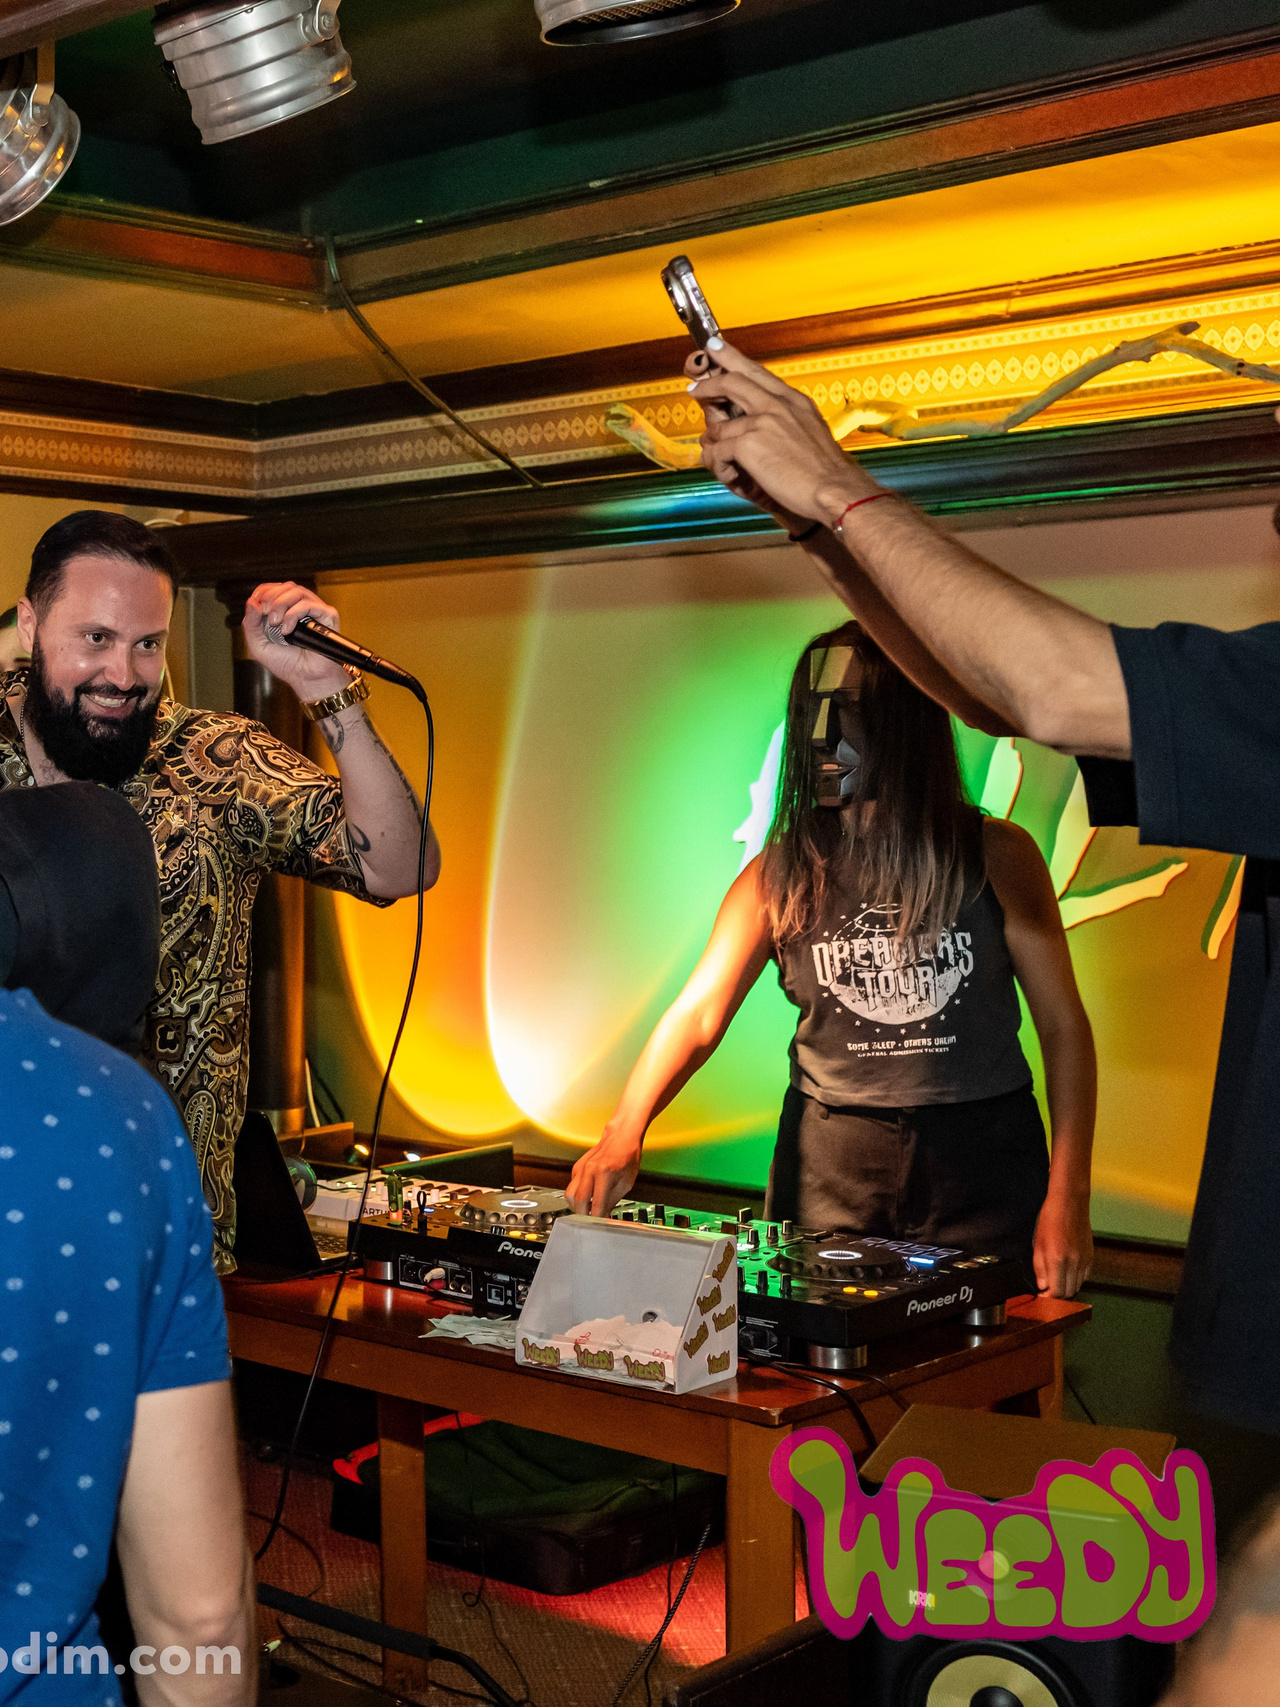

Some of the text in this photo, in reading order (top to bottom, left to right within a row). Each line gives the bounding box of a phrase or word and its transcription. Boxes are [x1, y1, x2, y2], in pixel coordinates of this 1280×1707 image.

[858, 965, 938, 1012] TOUR
[847, 1035, 956, 1051] SOME SLEEP OTHERS DREAM
[906, 1286, 974, 1316] Pioneer DJ
